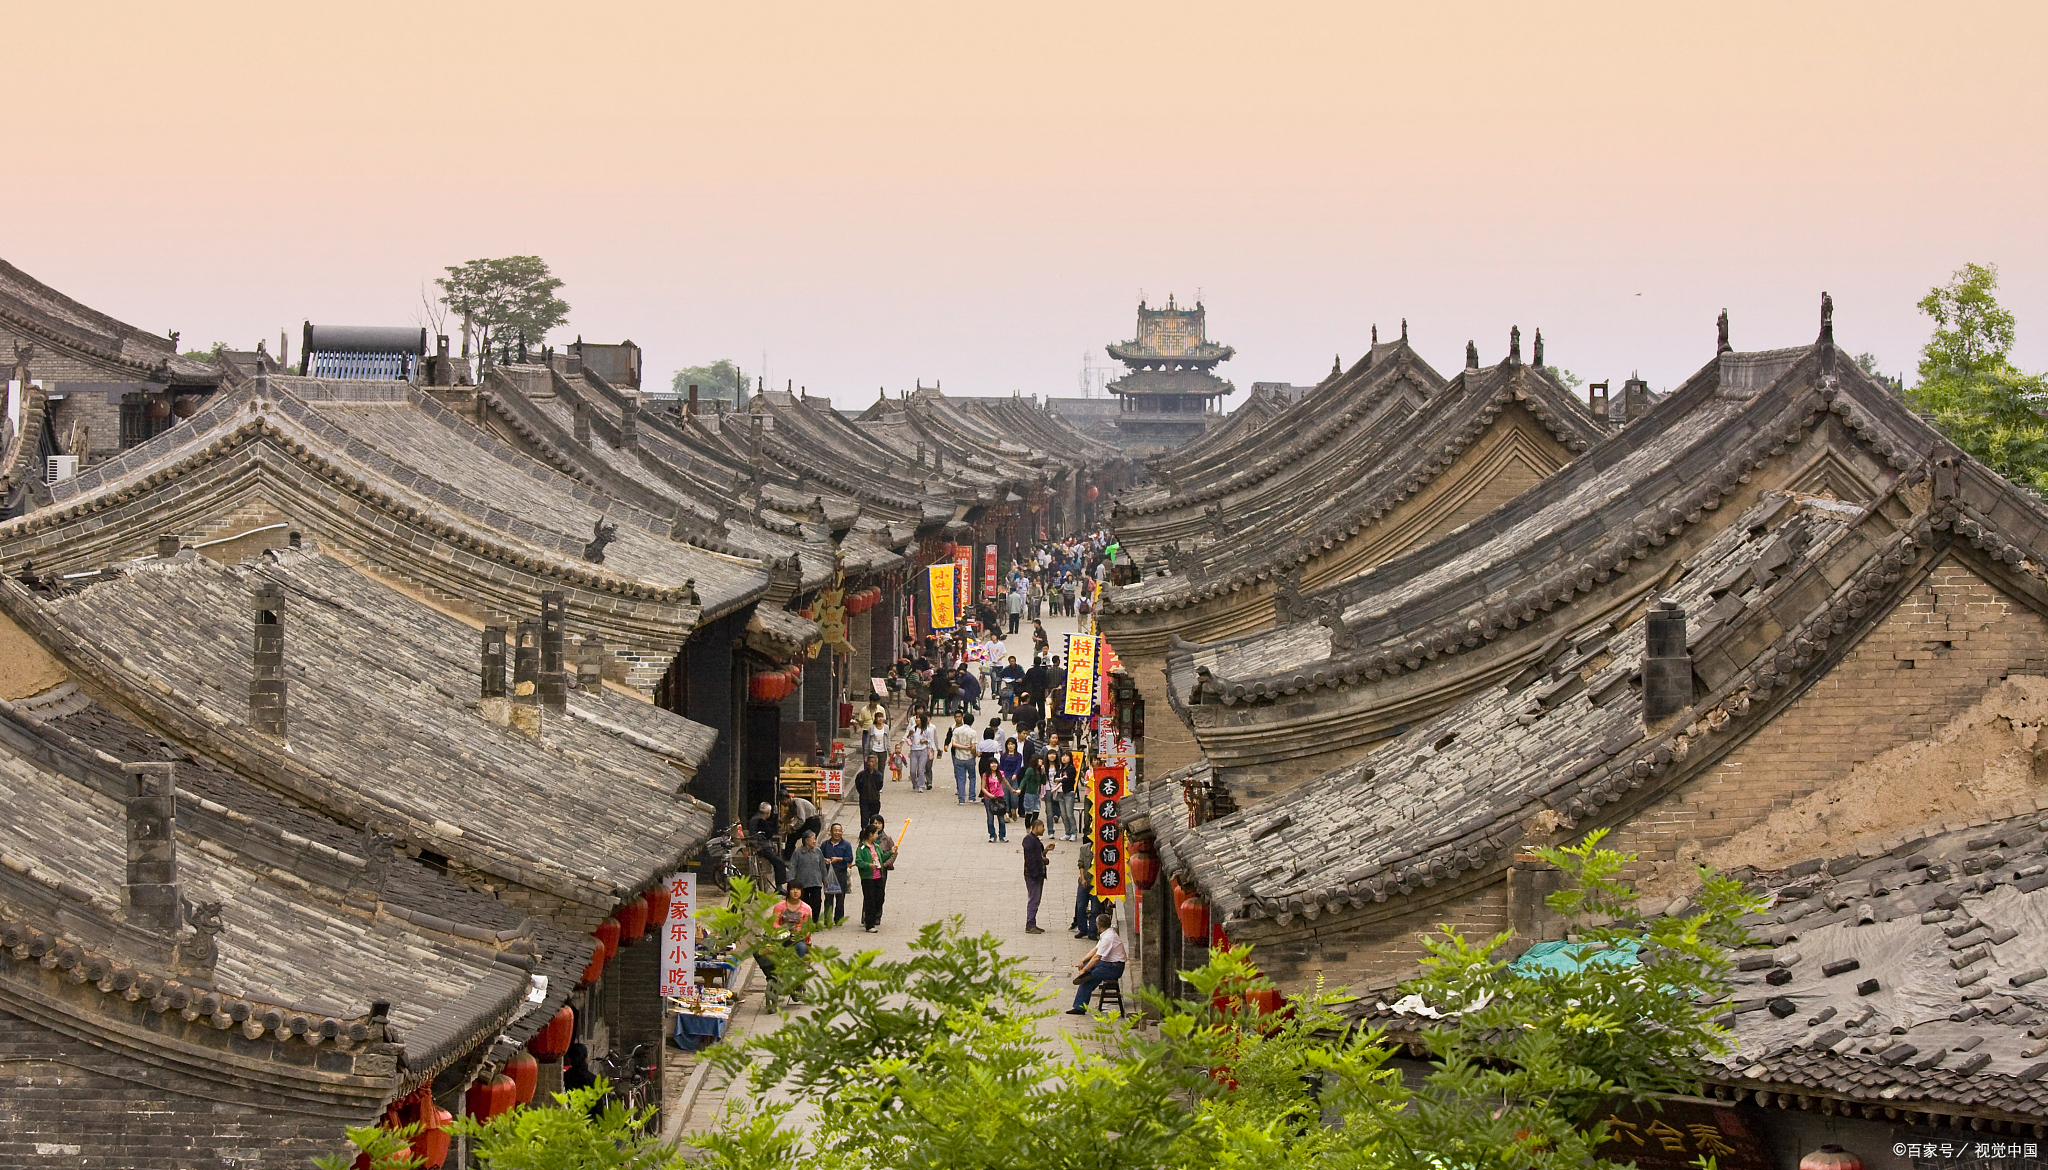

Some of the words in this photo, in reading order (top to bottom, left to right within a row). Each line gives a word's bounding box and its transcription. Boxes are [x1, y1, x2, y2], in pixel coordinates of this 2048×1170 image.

[935, 570, 950, 624] 小吃一条巷
[1070, 639, 1091, 712] 特产超市
[1102, 779, 1118, 886] 杏花村酒楼
[669, 879, 688, 986] 农家乐小吃
[661, 986, 674, 995] 早点
[679, 986, 693, 995] 夜餐
